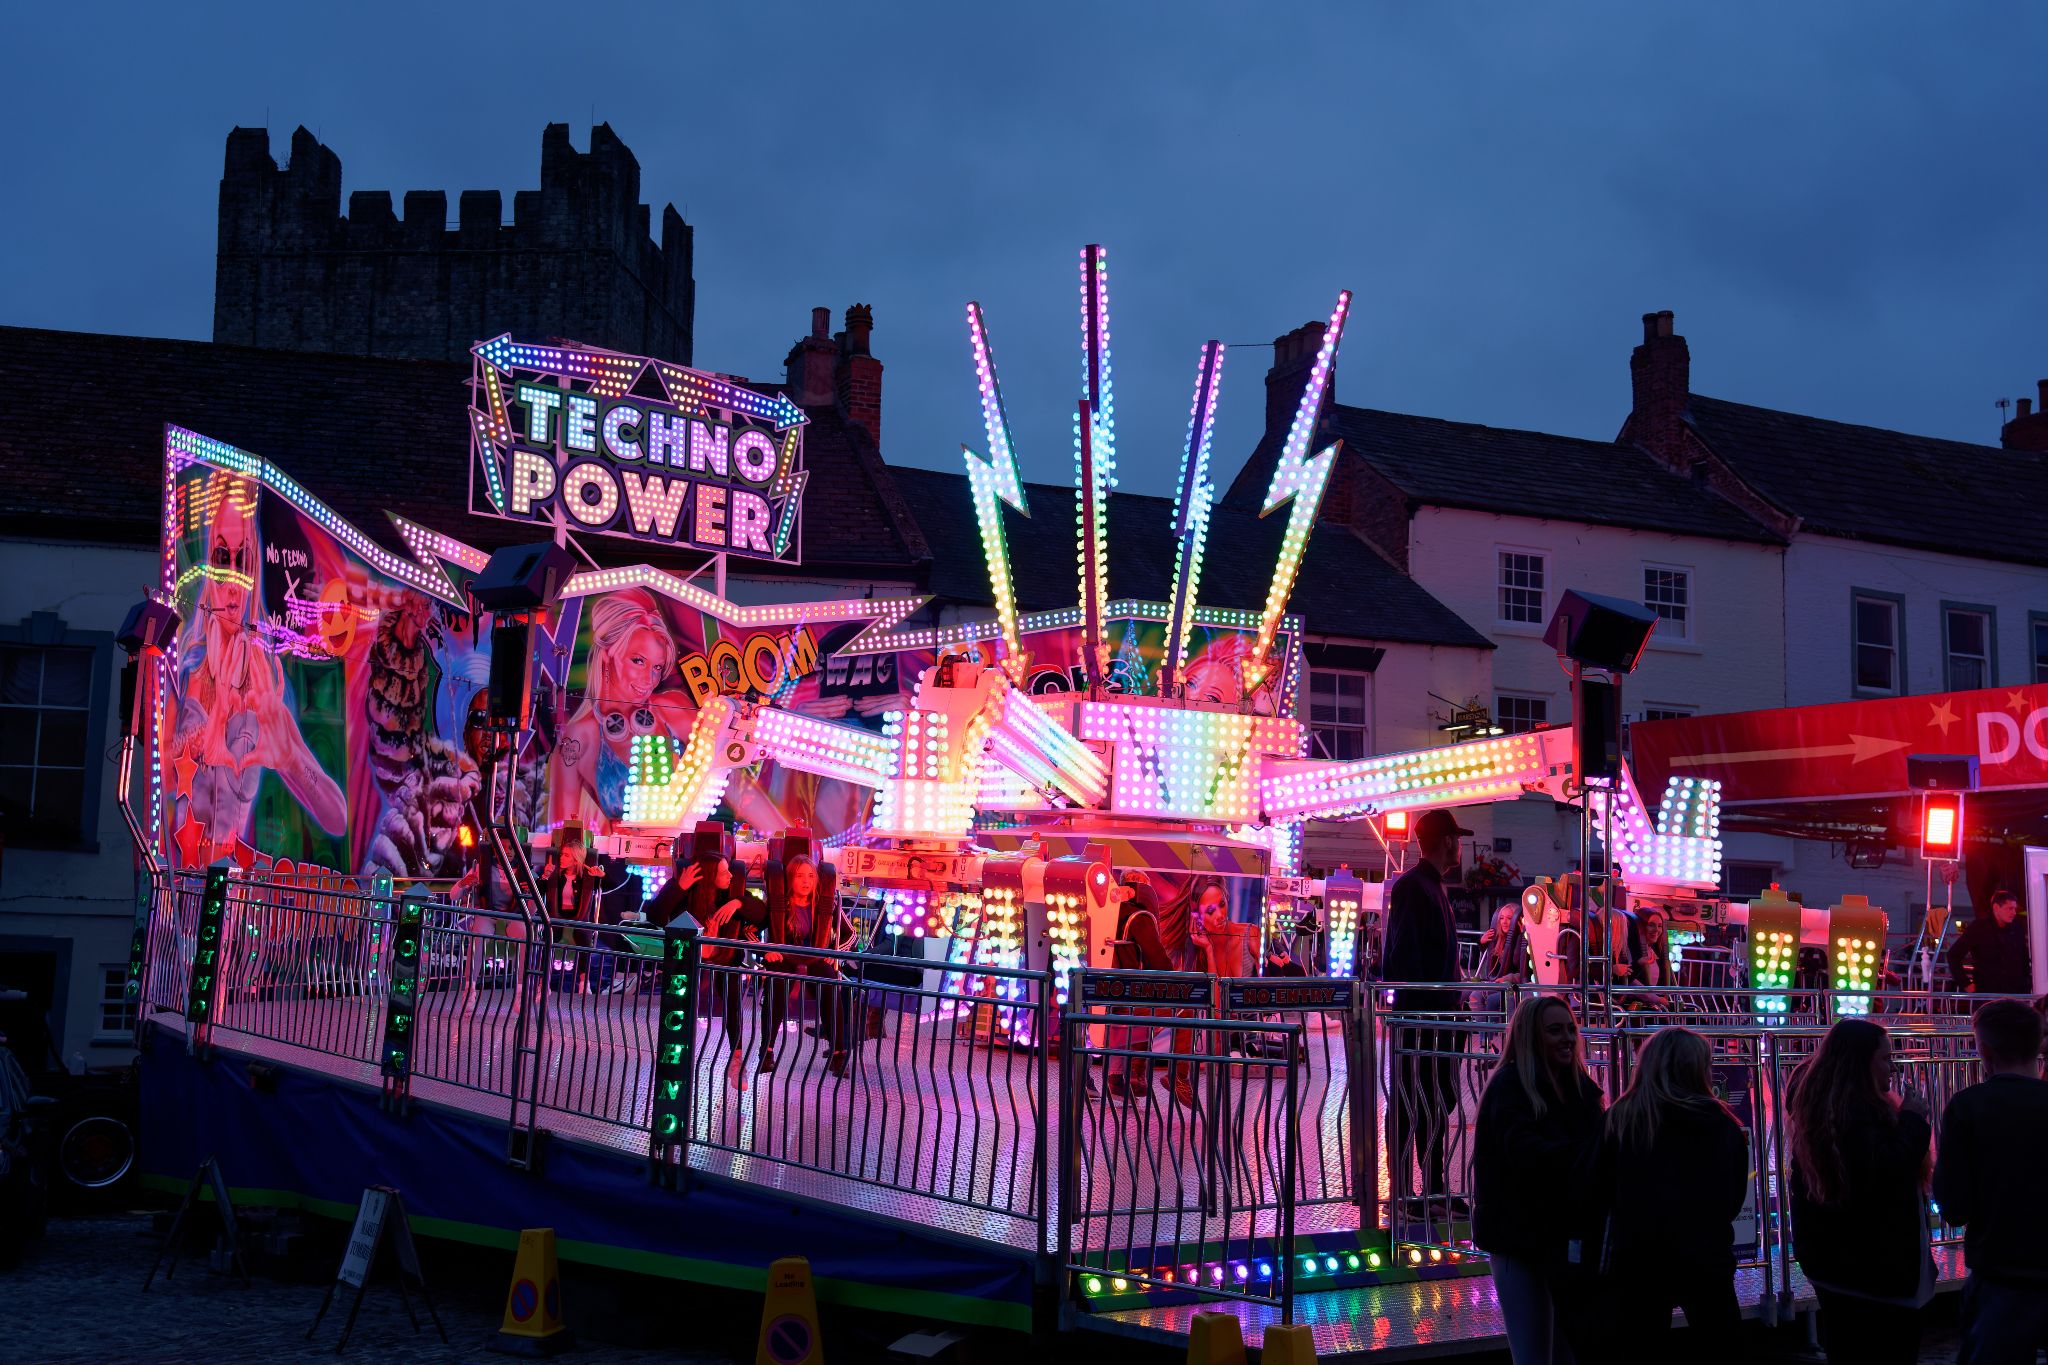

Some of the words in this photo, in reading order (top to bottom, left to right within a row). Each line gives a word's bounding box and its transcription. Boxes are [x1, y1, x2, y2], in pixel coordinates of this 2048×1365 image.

[516, 382, 779, 483] TECHNO
[510, 448, 773, 553] POWER
[266, 541, 280, 564] NO
[678, 626, 819, 709] BOOM
[814, 651, 894, 687] SWAG
[847, 851, 856, 873] OUT
[861, 853, 876, 872] 3
[1289, 880, 1301, 892] 2
[1700, 904, 1713, 920] 3
[1720, 903, 1728, 923] OUT
[1095, 980, 1125, 997] NO
[1130, 981, 1194, 999] ENTRY
[1243, 988, 1271, 1005] NO
[1275, 987, 1336, 1003] ENTRY
[657, 938, 691, 1135] TECHNO
